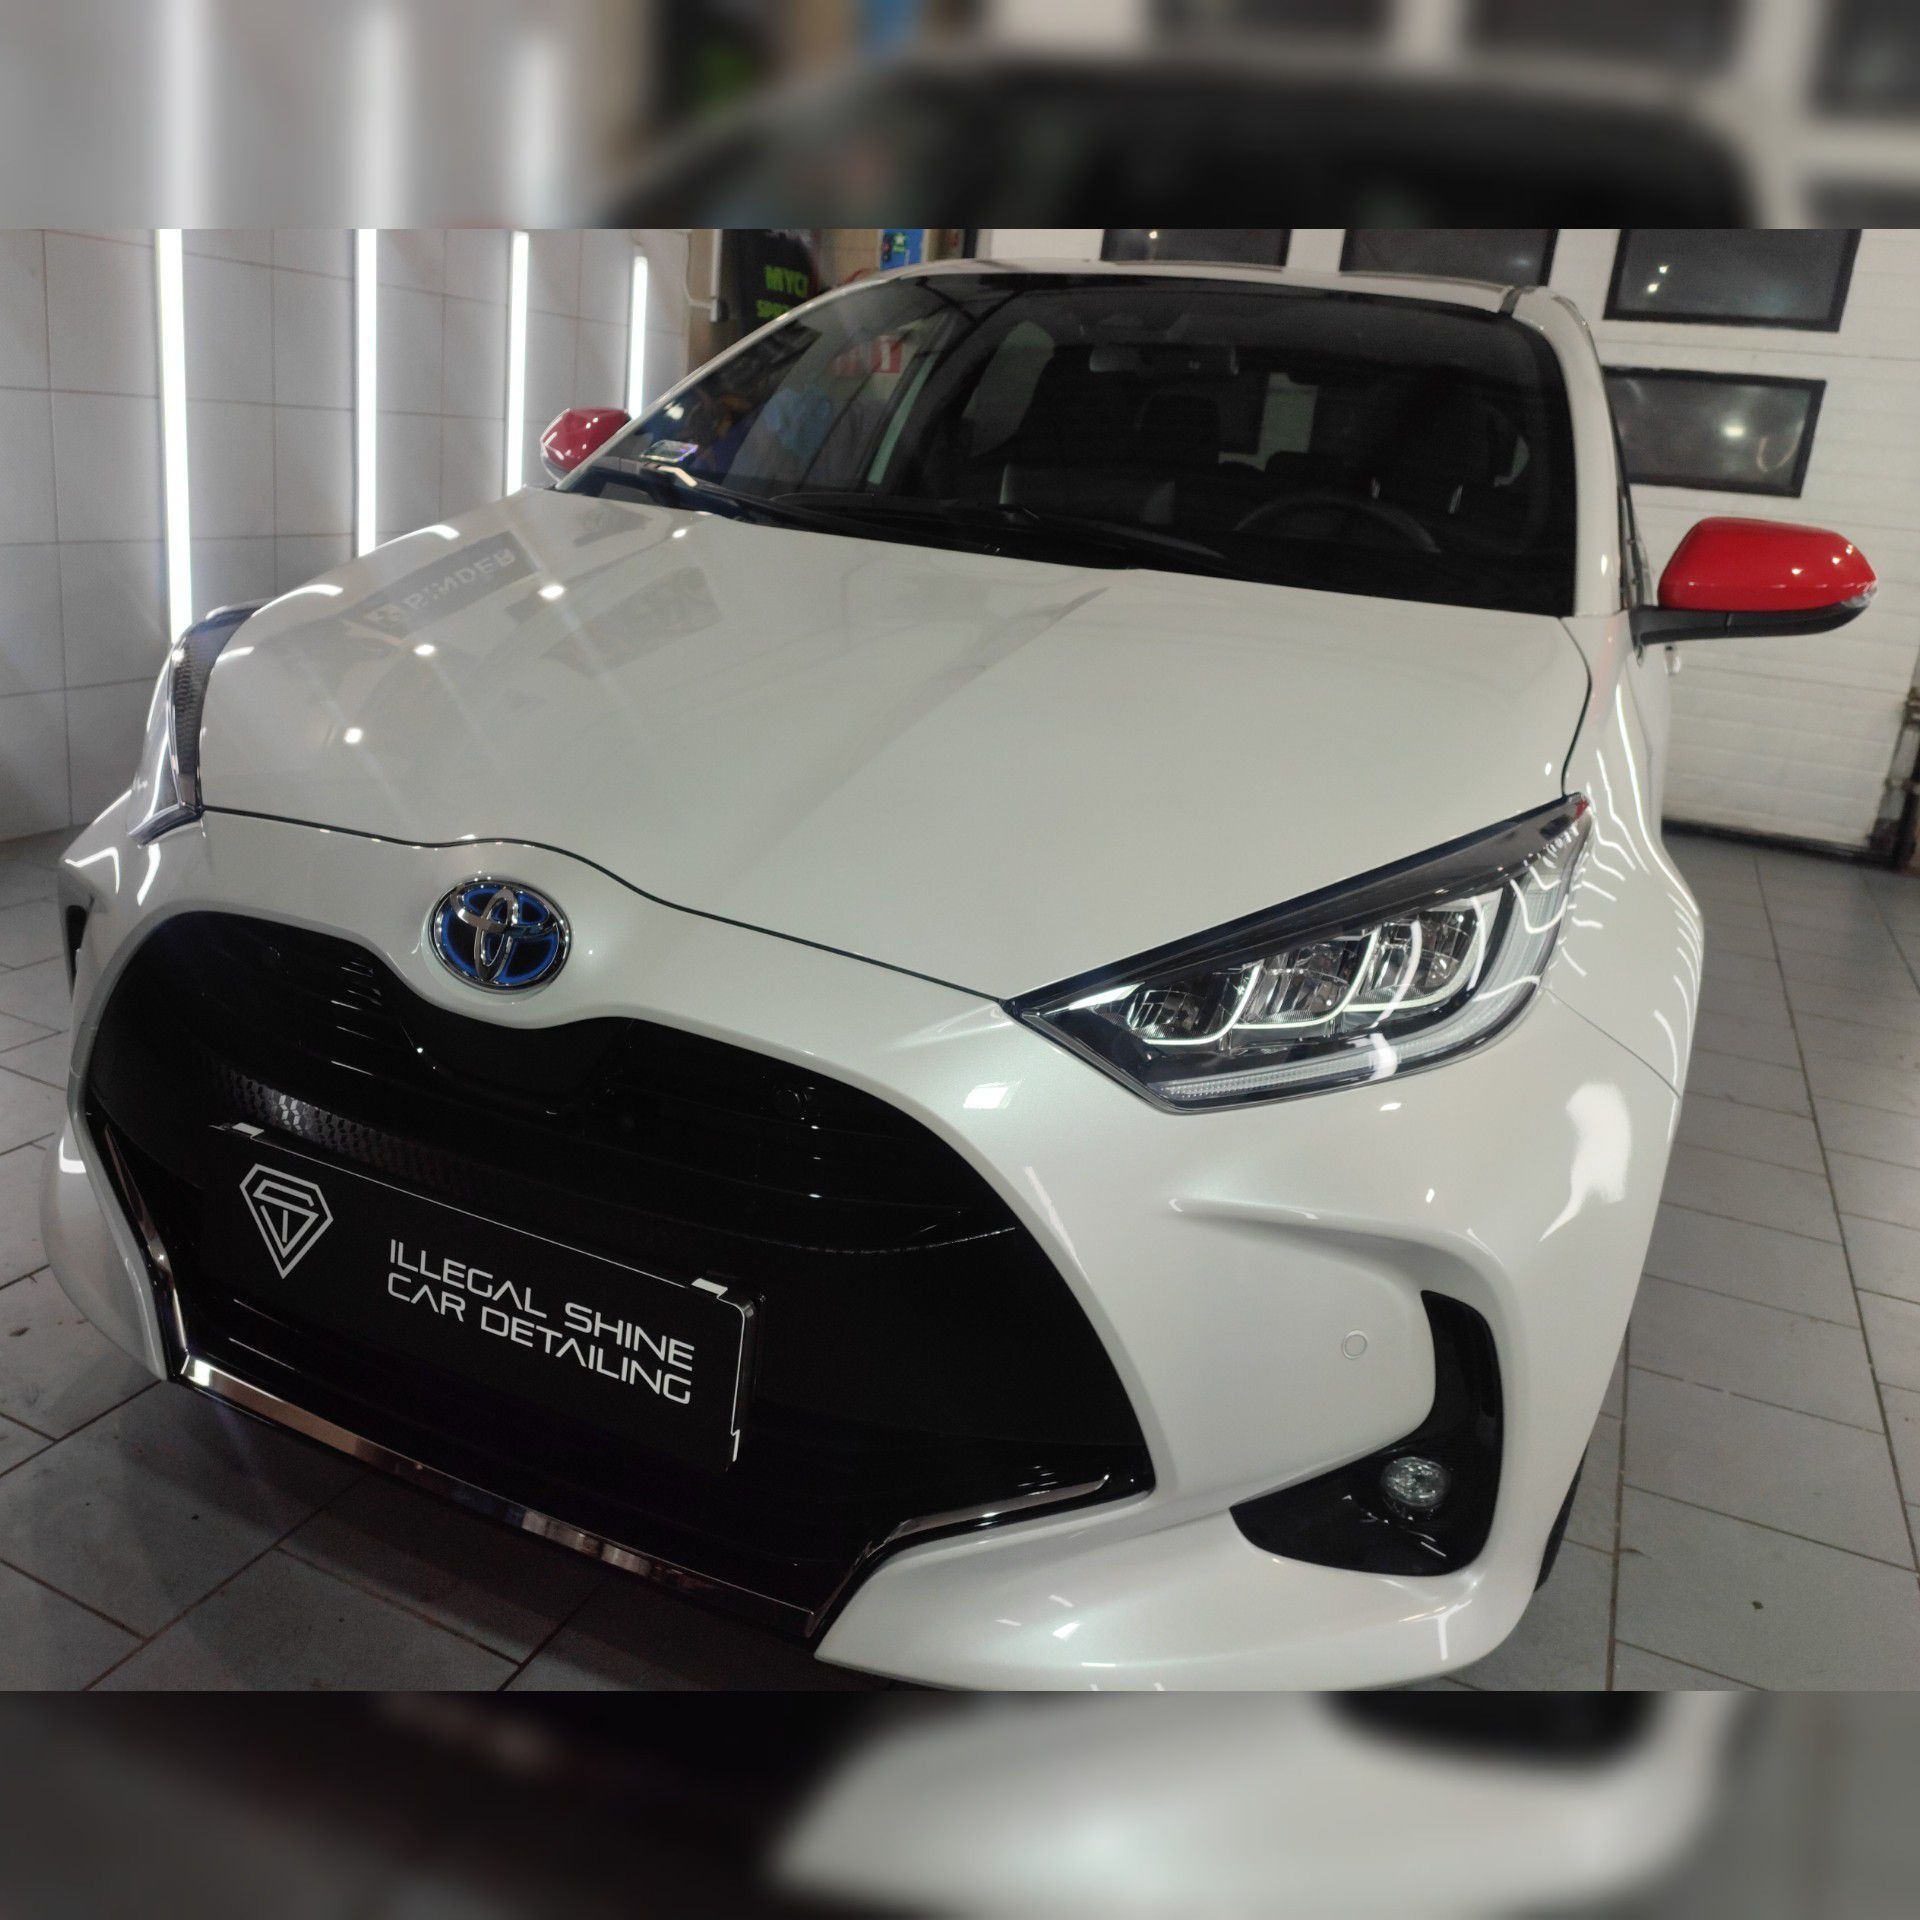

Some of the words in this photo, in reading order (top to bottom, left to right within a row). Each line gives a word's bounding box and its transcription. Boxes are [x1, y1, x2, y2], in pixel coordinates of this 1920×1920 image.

[387, 1272, 466, 1323] CAR
[480, 1305, 692, 1405] DETAILING
[390, 1239, 547, 1319] ILLEGAL
[564, 1302, 695, 1372] SHINE
